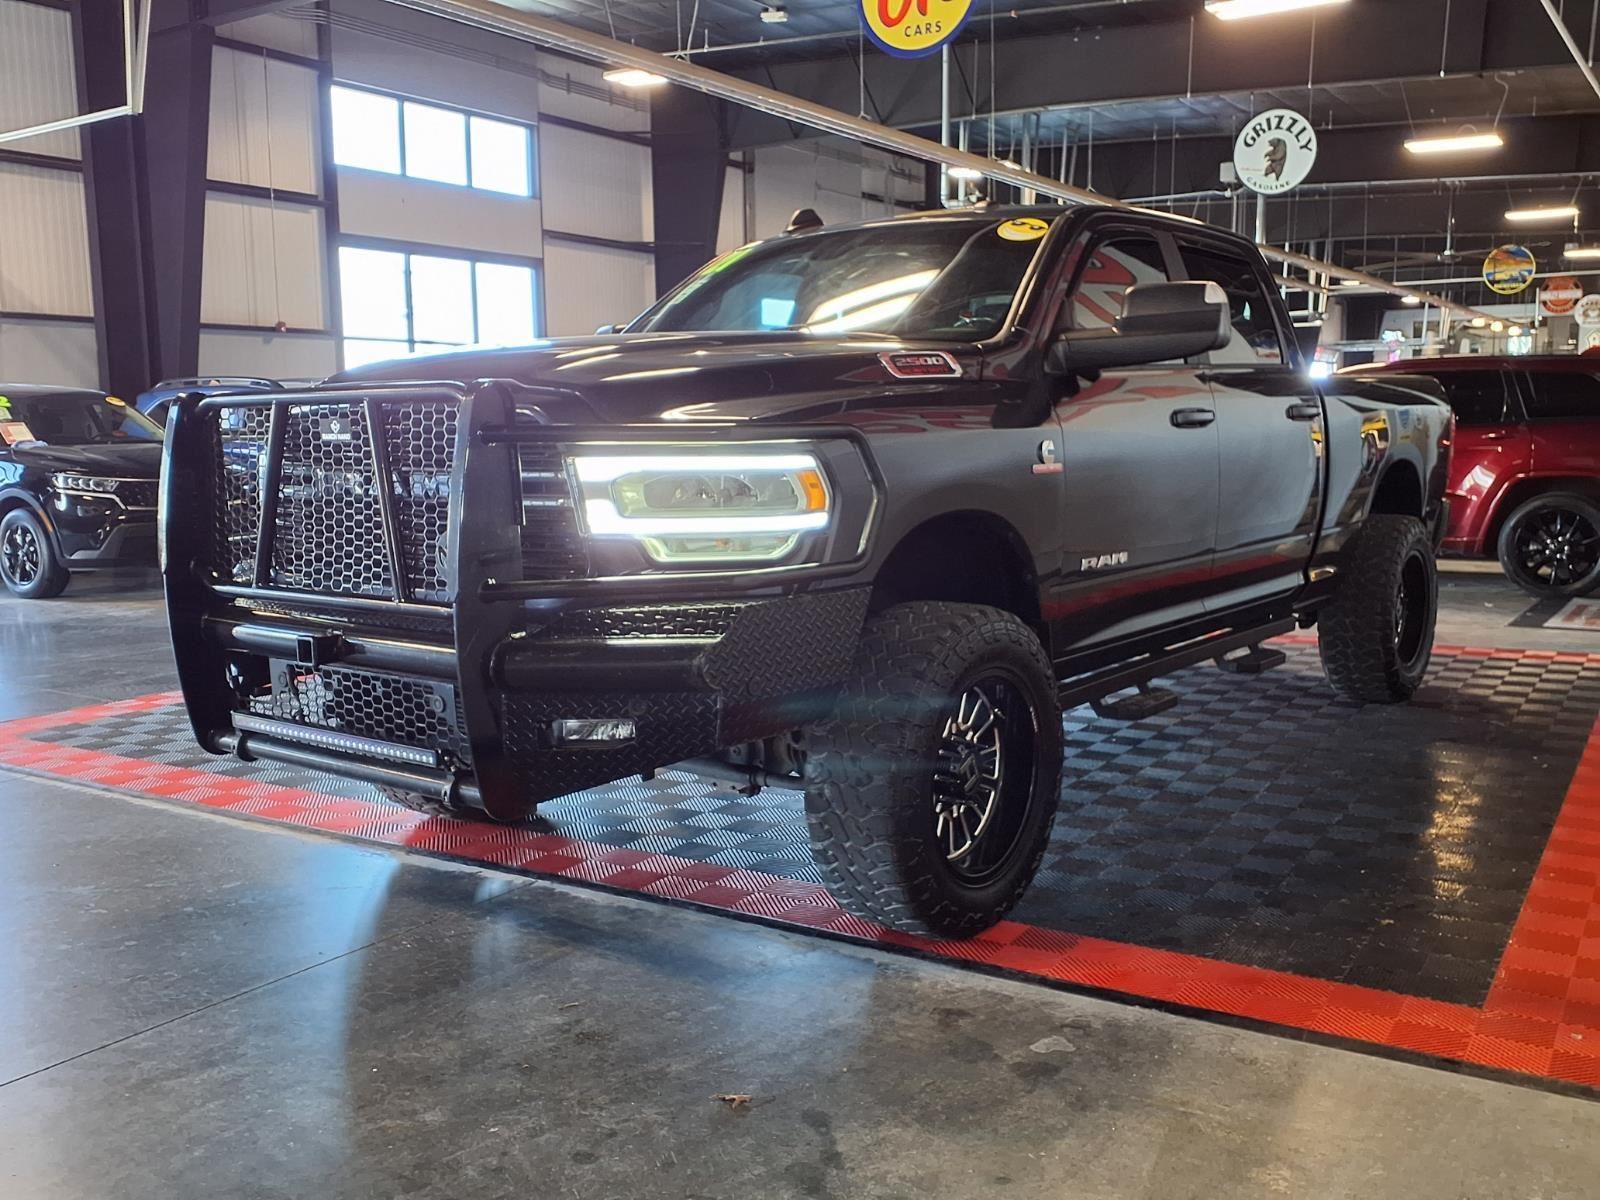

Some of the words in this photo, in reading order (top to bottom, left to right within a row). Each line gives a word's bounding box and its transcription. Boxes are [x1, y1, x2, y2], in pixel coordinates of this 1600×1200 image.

[904, 21, 942, 37] CARS
[1243, 114, 1313, 152] GRIZZLY
[894, 356, 945, 367] 2500
[1080, 551, 1129, 572] RAM
